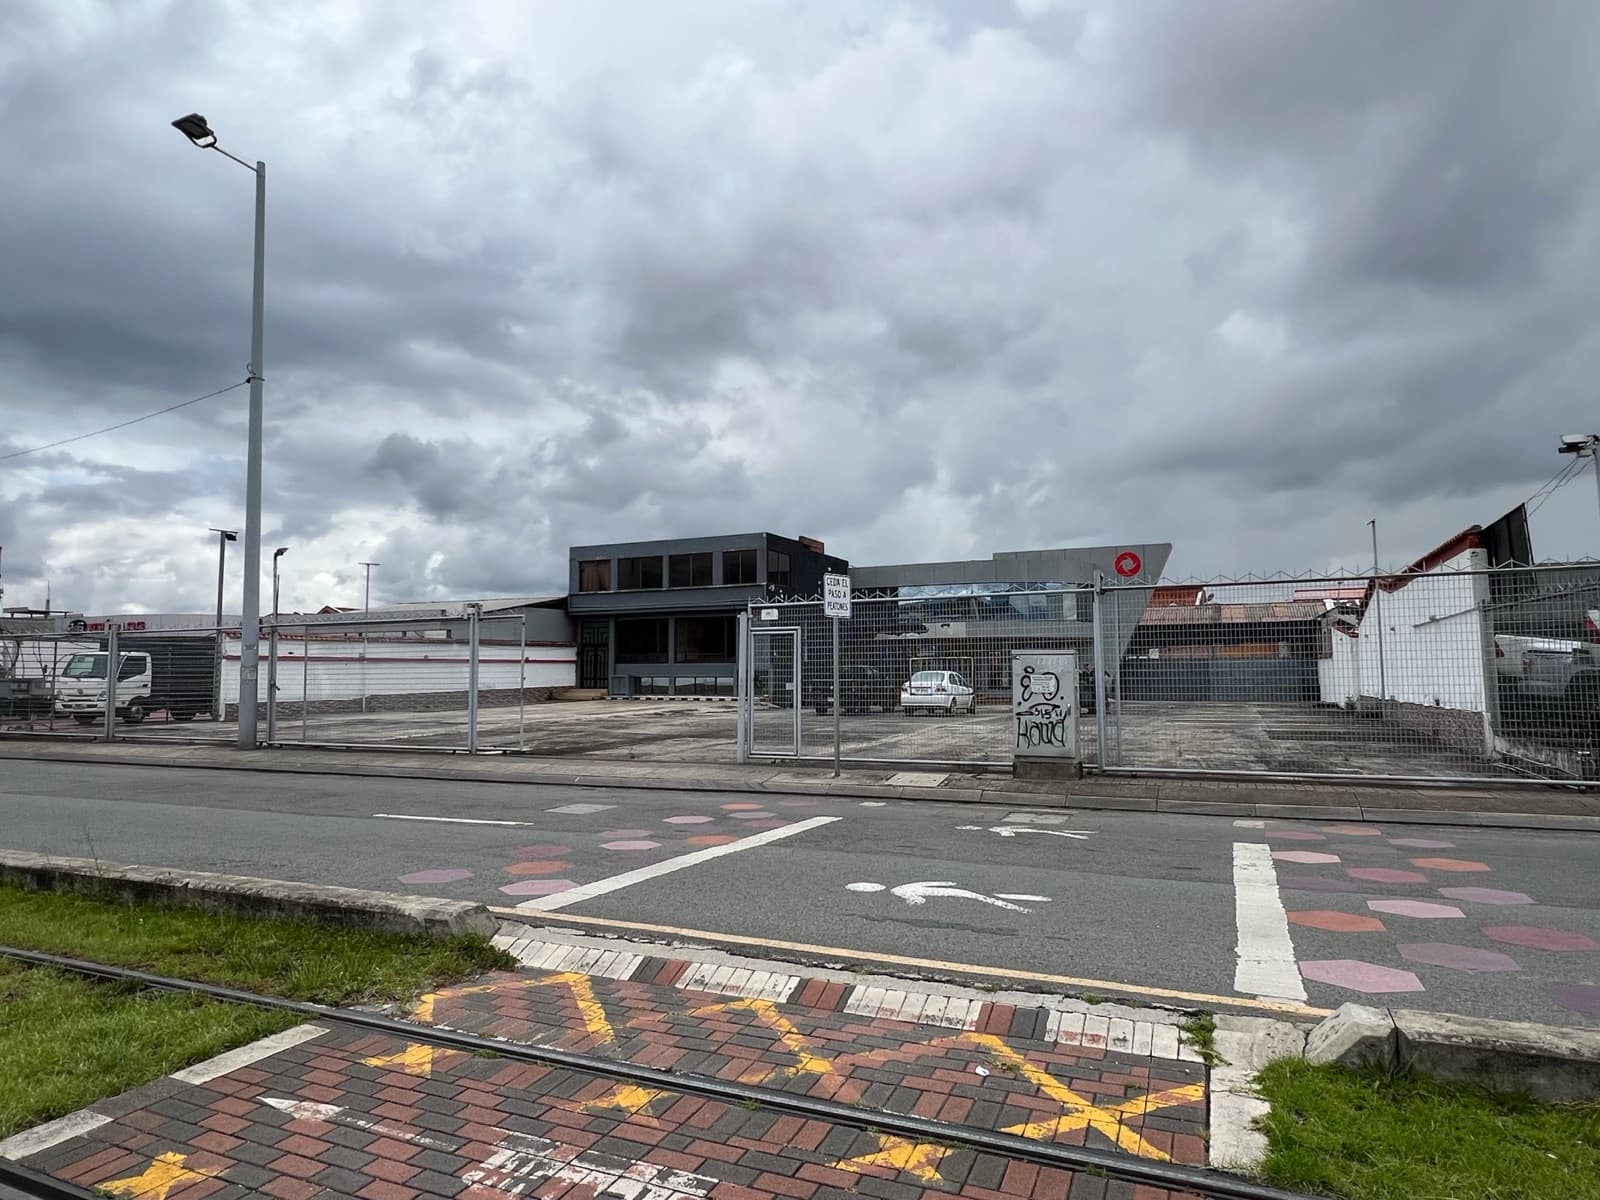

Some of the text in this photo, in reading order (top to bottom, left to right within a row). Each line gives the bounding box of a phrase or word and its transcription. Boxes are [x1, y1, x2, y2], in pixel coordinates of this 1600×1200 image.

[841, 578, 848, 588] EL
[828, 589, 841, 599] PASO
[827, 601, 848, 611] PEATONES
